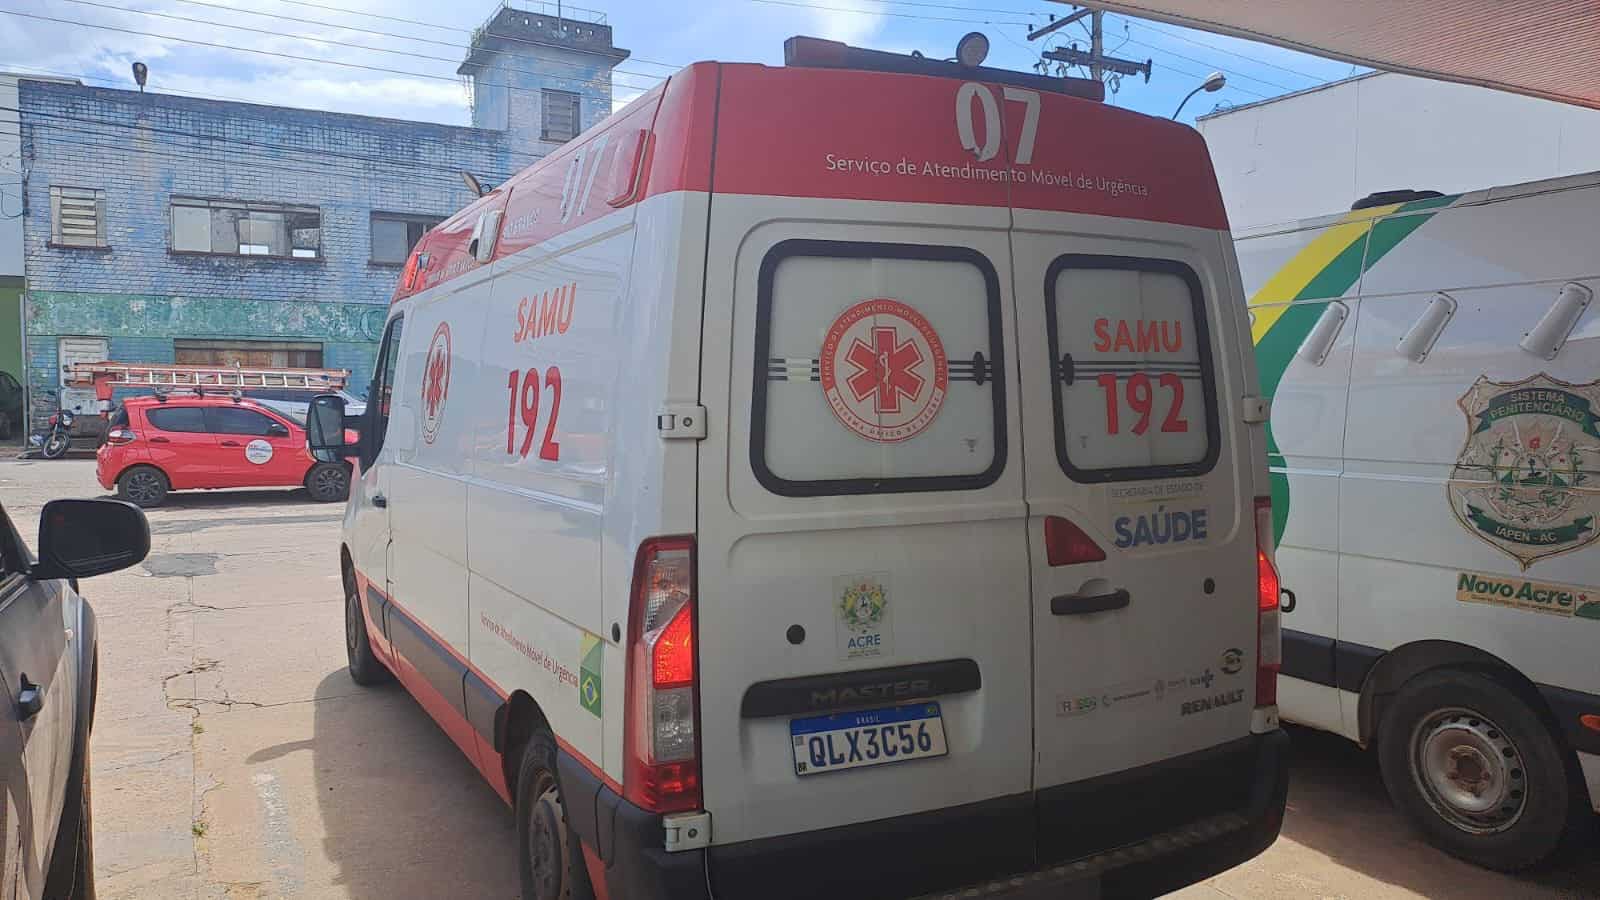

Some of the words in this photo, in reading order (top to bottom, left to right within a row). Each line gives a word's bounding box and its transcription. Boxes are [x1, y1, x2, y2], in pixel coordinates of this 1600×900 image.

[955, 82, 1040, 164] 07
[825, 153, 891, 176] Serviço
[895, 157, 917, 177] de
[921, 160, 1027, 184] Atendimento
[1031, 169, 1073, 189] Móvel
[1076, 173, 1093, 190] de
[1096, 176, 1148, 196] Urgência
[514, 282, 577, 343] SAMU
[1093, 318, 1183, 353] SAMU
[507, 366, 562, 461] 192
[1097, 372, 1188, 436] 192
[1510, 391, 1566, 403] SISTEMA
[1114, 506, 1208, 548] SAÚDE
[1457, 573, 1514, 598] Novo
[1515, 582, 1573, 606] Acre
[847, 633, 881, 649] ACRE
[809, 678, 932, 705] MASTER
[1180, 689, 1245, 716] RENAULT
[808, 722, 932, 768] QLX3C56
